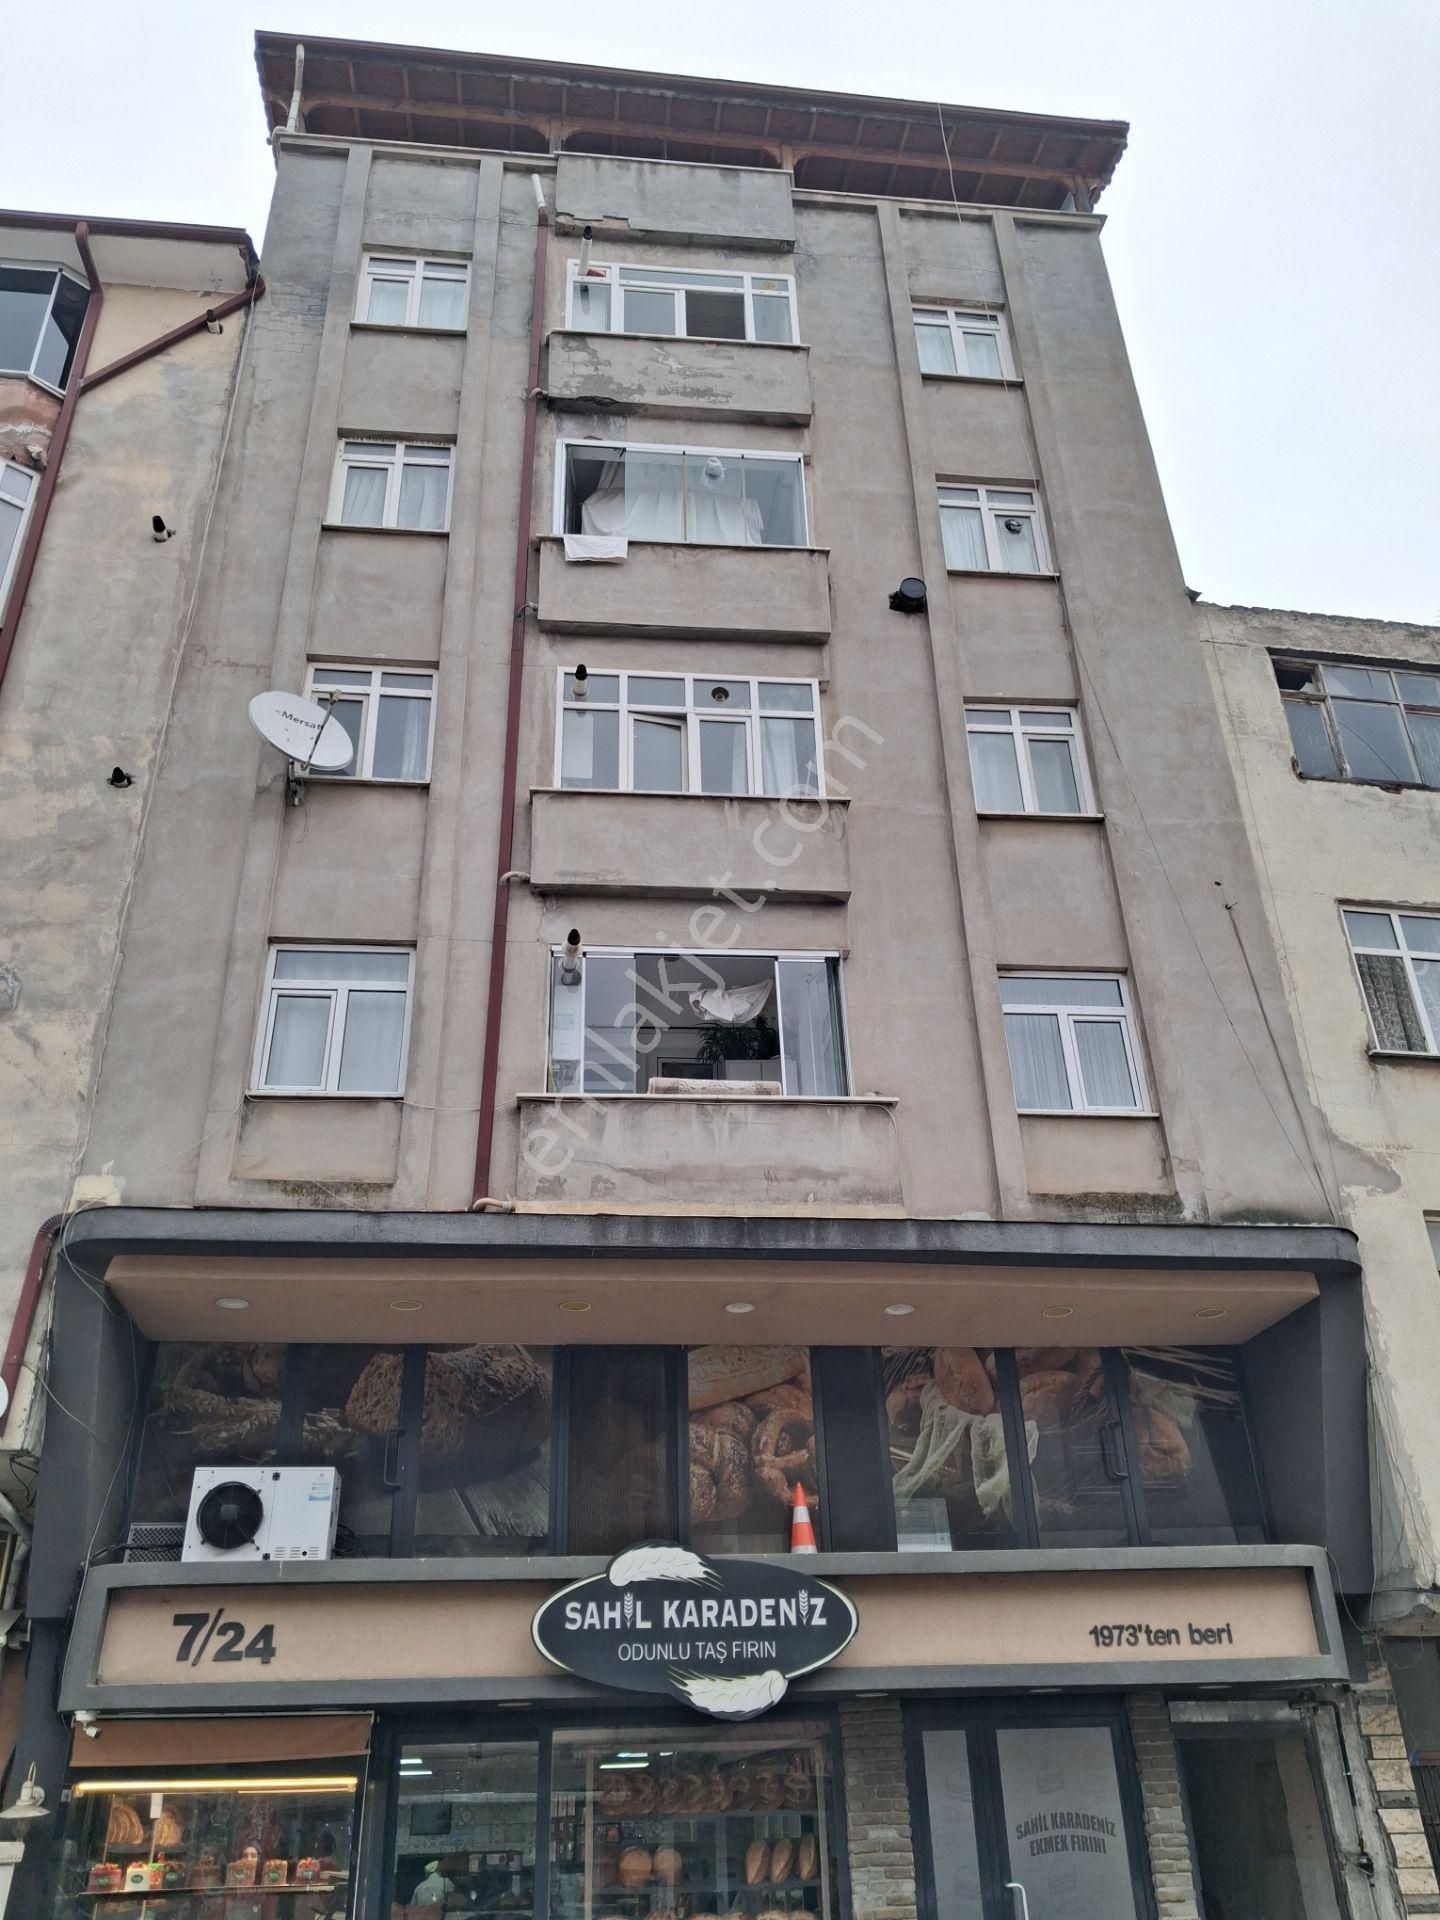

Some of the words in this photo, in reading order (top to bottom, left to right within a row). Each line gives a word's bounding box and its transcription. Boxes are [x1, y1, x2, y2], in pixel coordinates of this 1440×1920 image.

[173, 1607, 276, 1667] 7/24
[1088, 1623, 1180, 1647] 1973'ten
[1188, 1622, 1233, 1645] beri
[618, 1643, 690, 1661] ODUNLU
[695, 1641, 727, 1663] TAŞ
[732, 1640, 776, 1659] FIRIN
[1029, 1835, 1069, 1856] EKMEK
